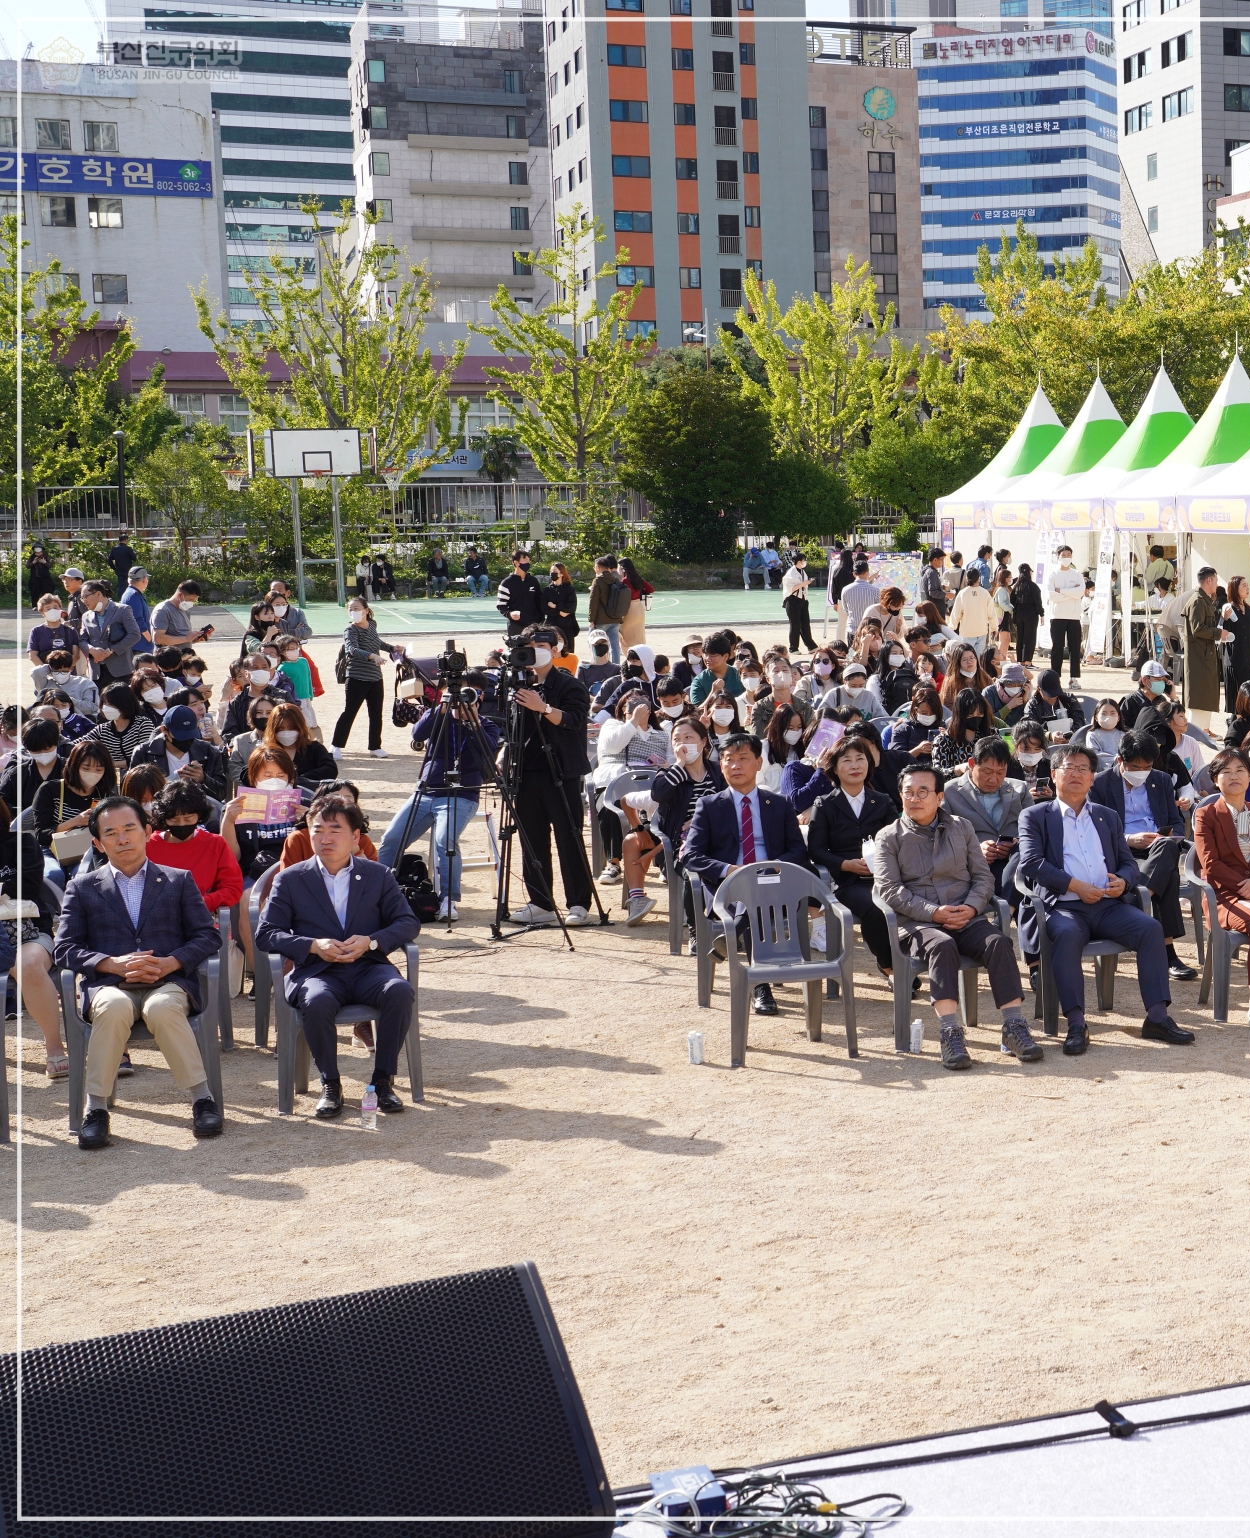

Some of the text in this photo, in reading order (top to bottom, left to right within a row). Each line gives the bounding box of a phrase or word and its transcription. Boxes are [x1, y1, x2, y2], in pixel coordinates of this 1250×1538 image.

[858, 121, 903, 150] 하루
[965, 121, 1060, 136] 부산더조은직업전문학교
[183, 168, 197, 178] 3F
